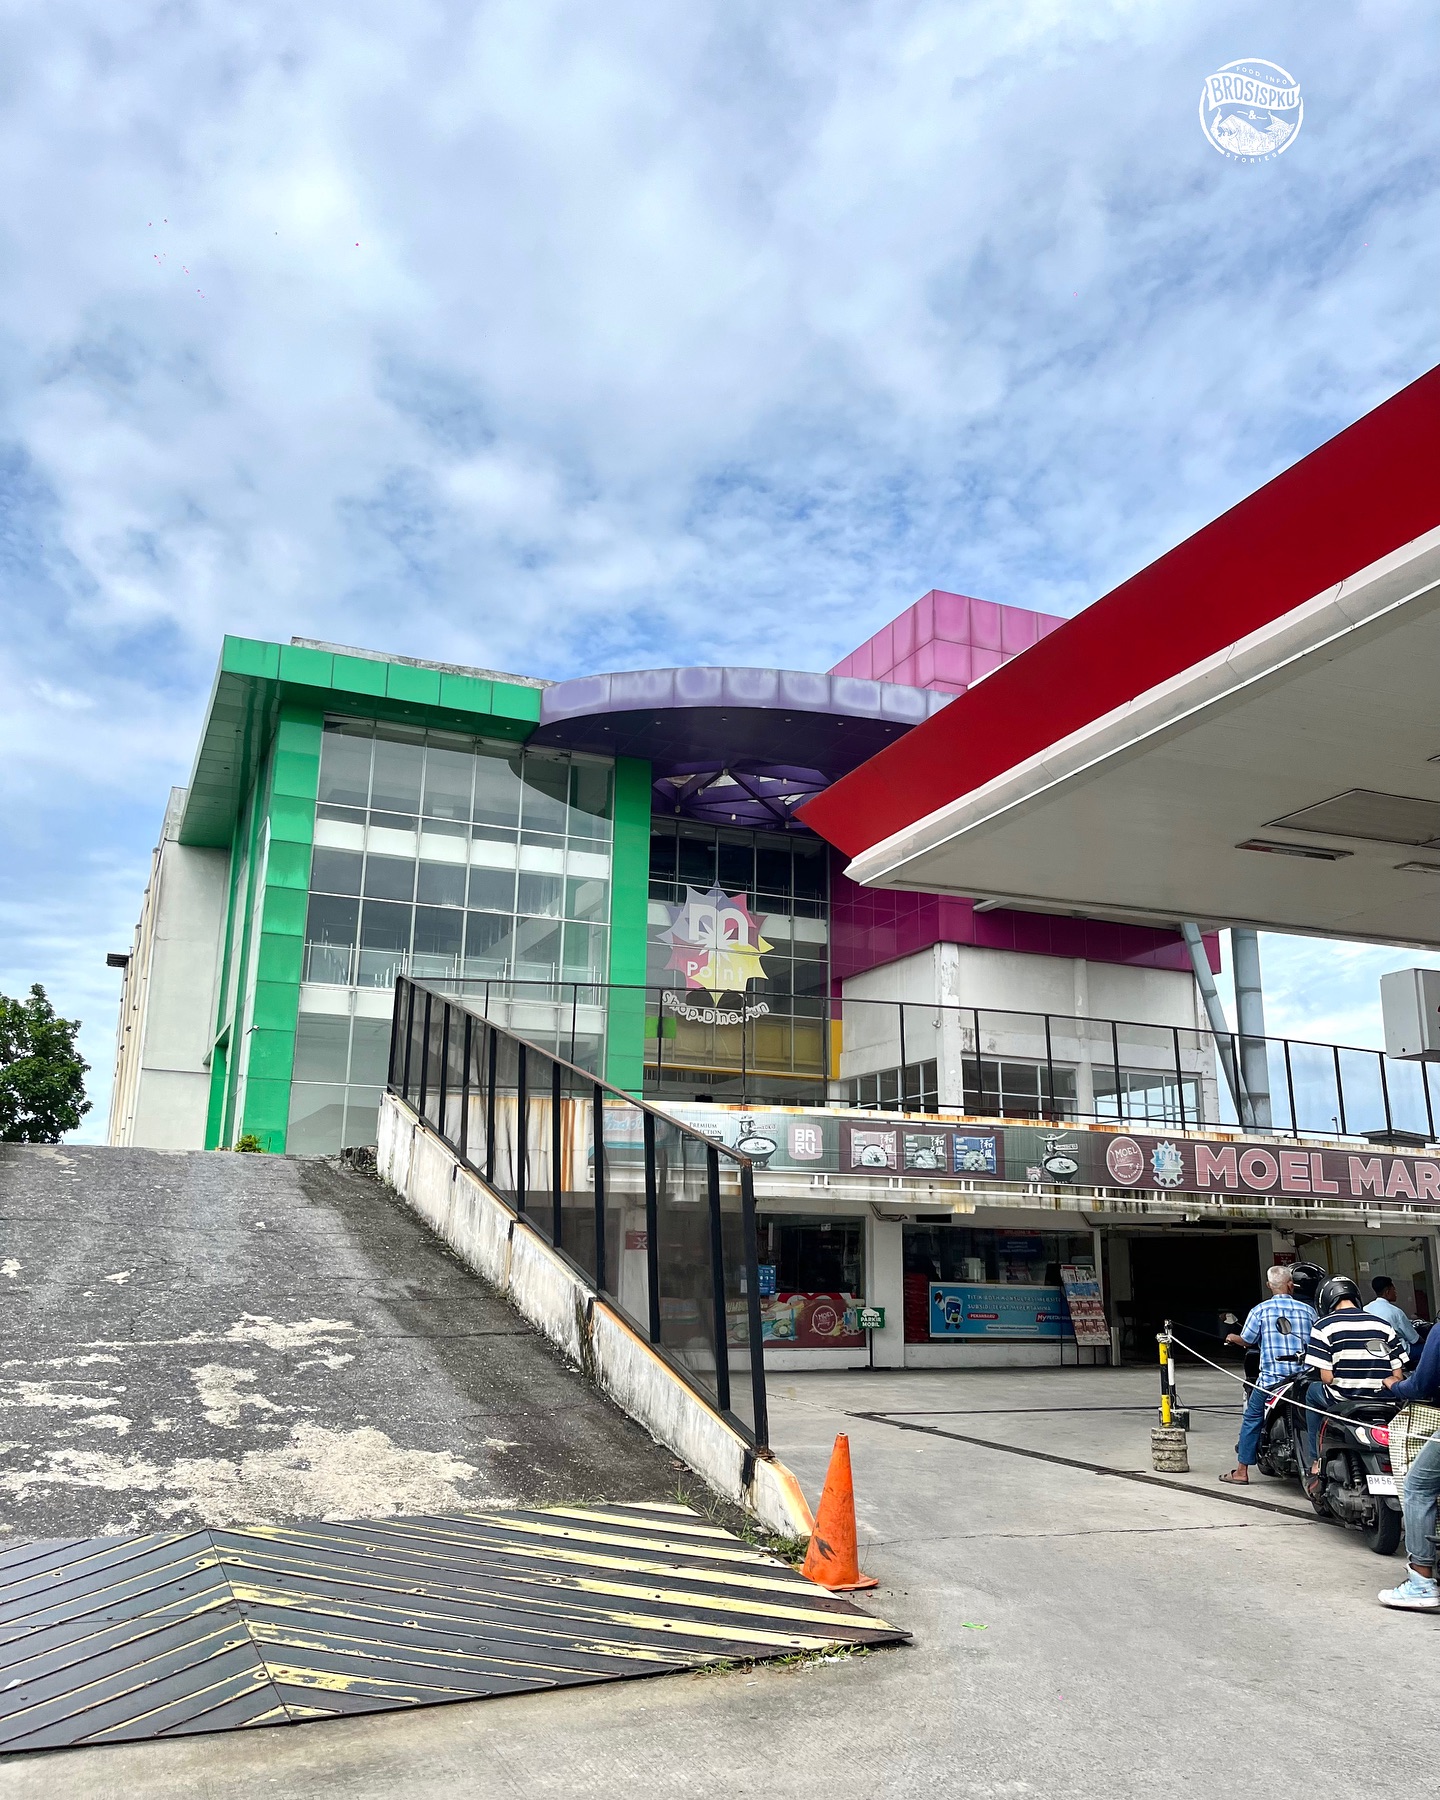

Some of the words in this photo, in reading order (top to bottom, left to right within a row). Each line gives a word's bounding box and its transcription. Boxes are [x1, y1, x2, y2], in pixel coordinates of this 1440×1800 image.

[687, 961, 744, 983] Pont
[1115, 1146, 1138, 1158] MOEL
[1194, 1144, 1339, 1194] MOEL
[1348, 1156, 1440, 1200] MAR
[1368, 1476, 1380, 1485] BM
[1381, 1477, 1393, 1486] 56
